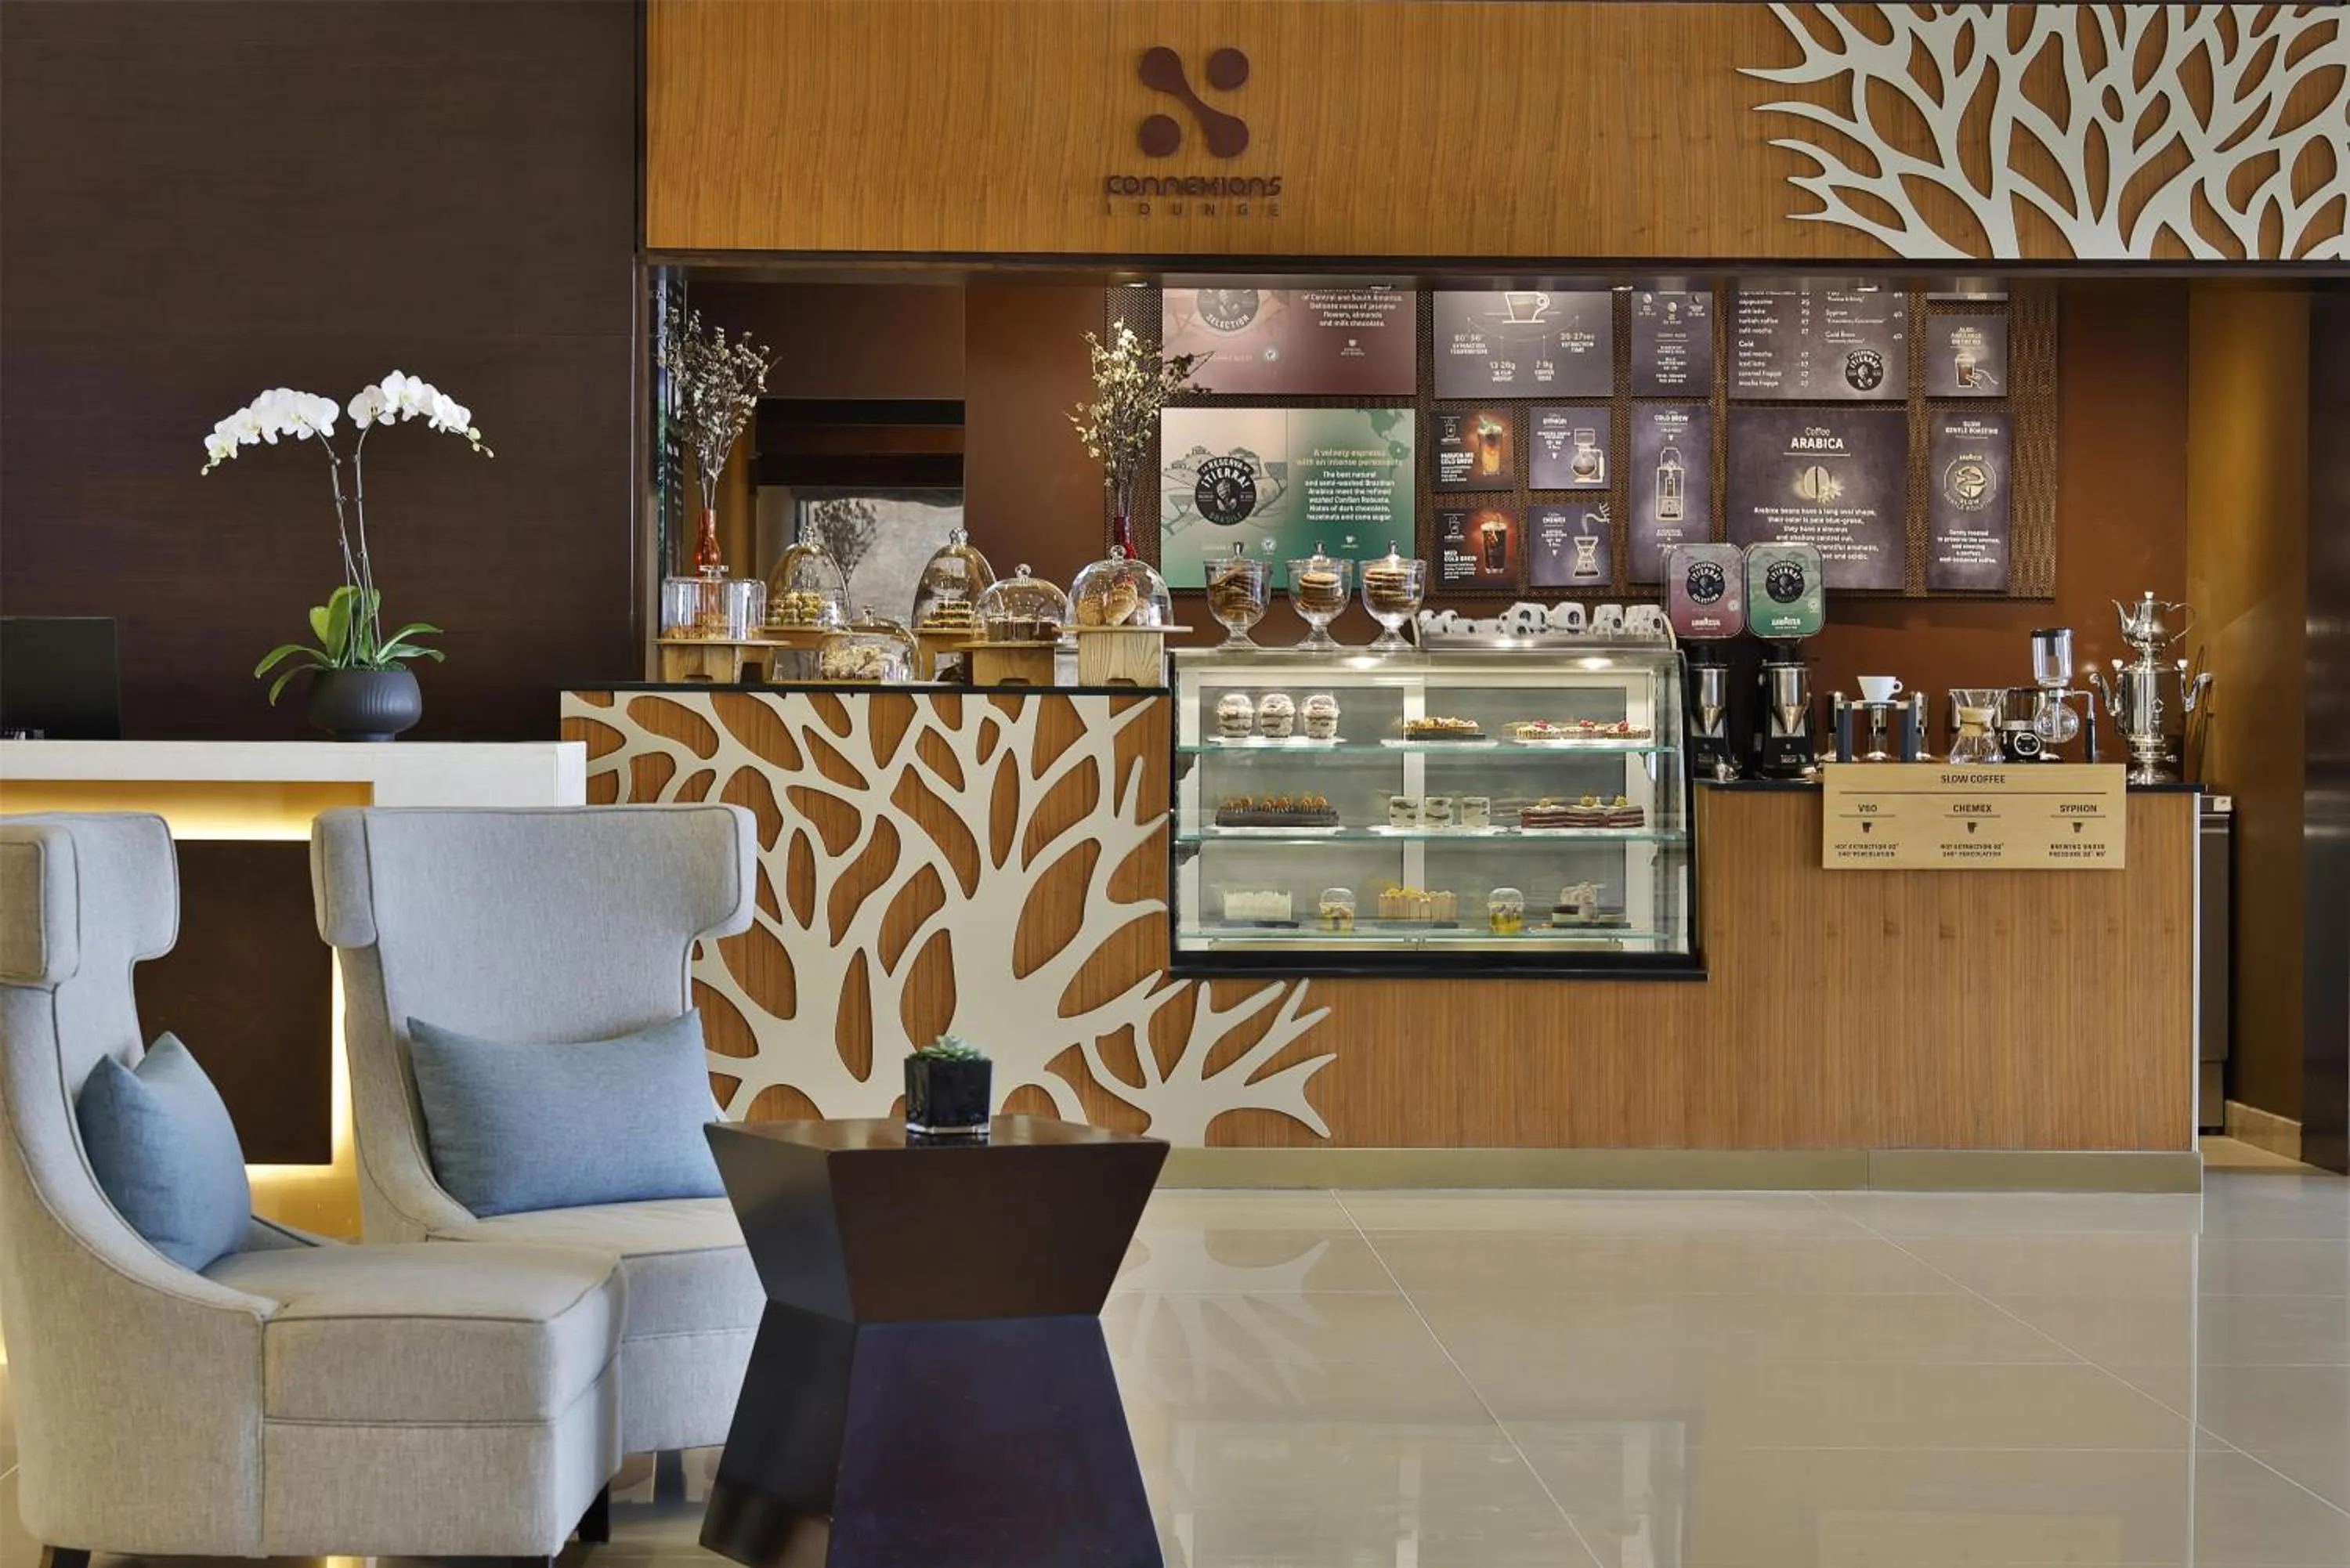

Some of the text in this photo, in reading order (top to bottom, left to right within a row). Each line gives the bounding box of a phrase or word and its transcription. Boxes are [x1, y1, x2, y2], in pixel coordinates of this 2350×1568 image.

[1206, 313, 1250, 330] SELECTION
[1805, 427, 1831, 436] Coffee
[1790, 437, 1845, 450] ARABICA
[1940, 774, 2006, 785] SLOW COFFEE
[1953, 804, 1992, 813] CHEMEX
[2059, 804, 2098, 813] SYPHON
